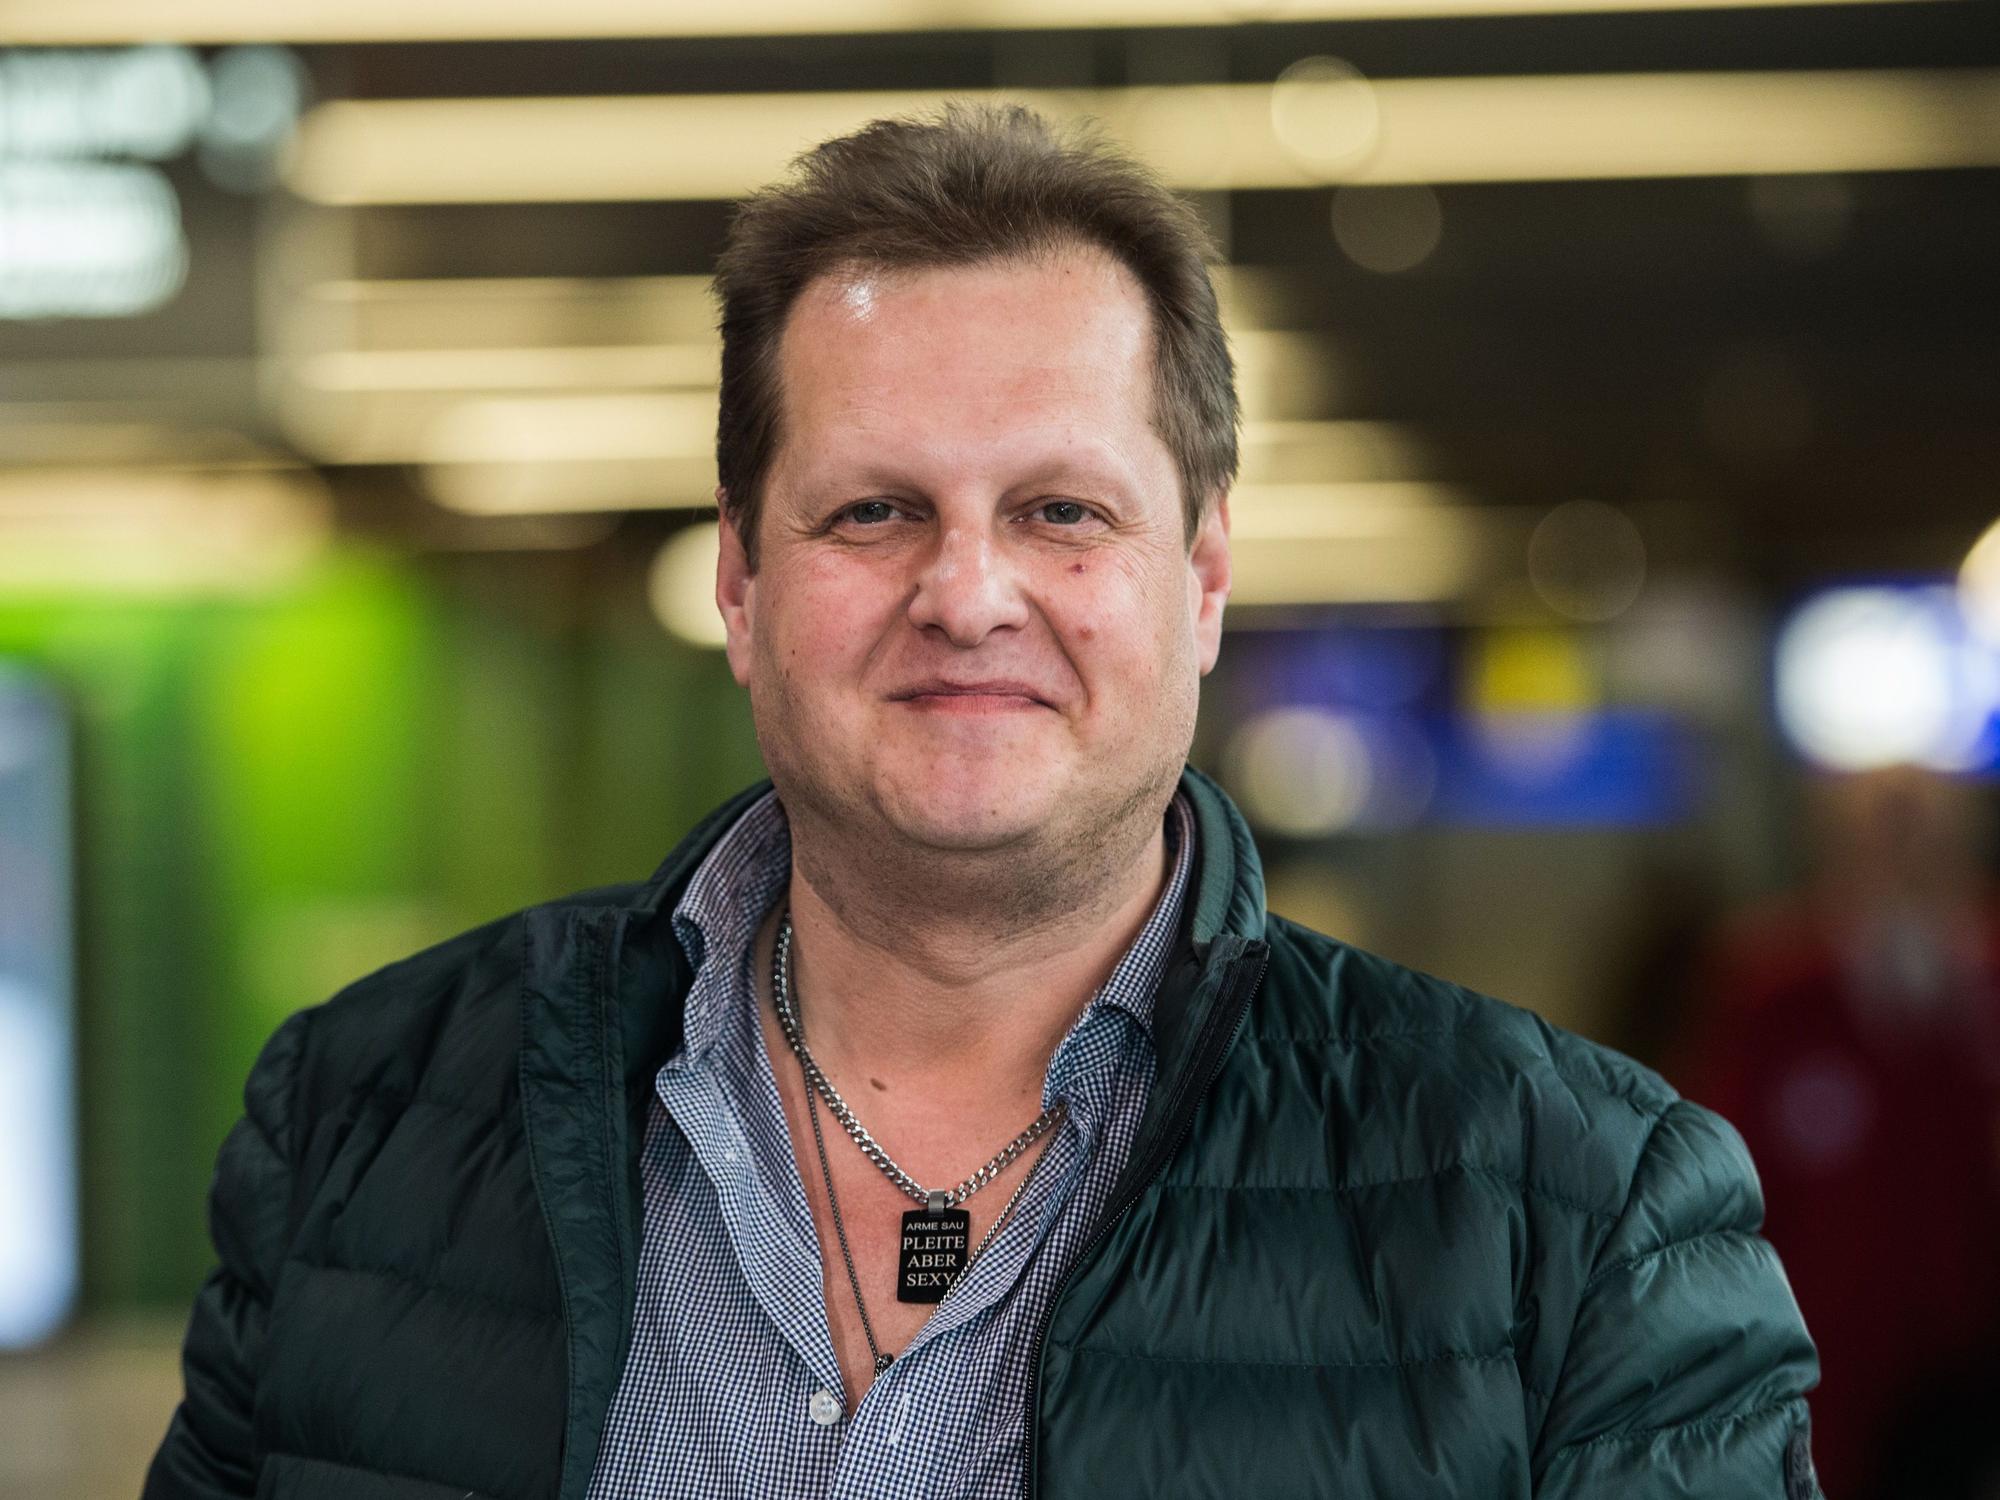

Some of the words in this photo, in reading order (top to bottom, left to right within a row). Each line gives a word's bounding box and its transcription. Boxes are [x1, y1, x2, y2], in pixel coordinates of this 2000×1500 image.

[906, 1222, 938, 1231] ARME
[941, 1222, 964, 1230] SAU
[903, 1236, 965, 1250] PLEITE
[907, 1254, 957, 1268] ABER
[907, 1272, 956, 1287] SEXY
